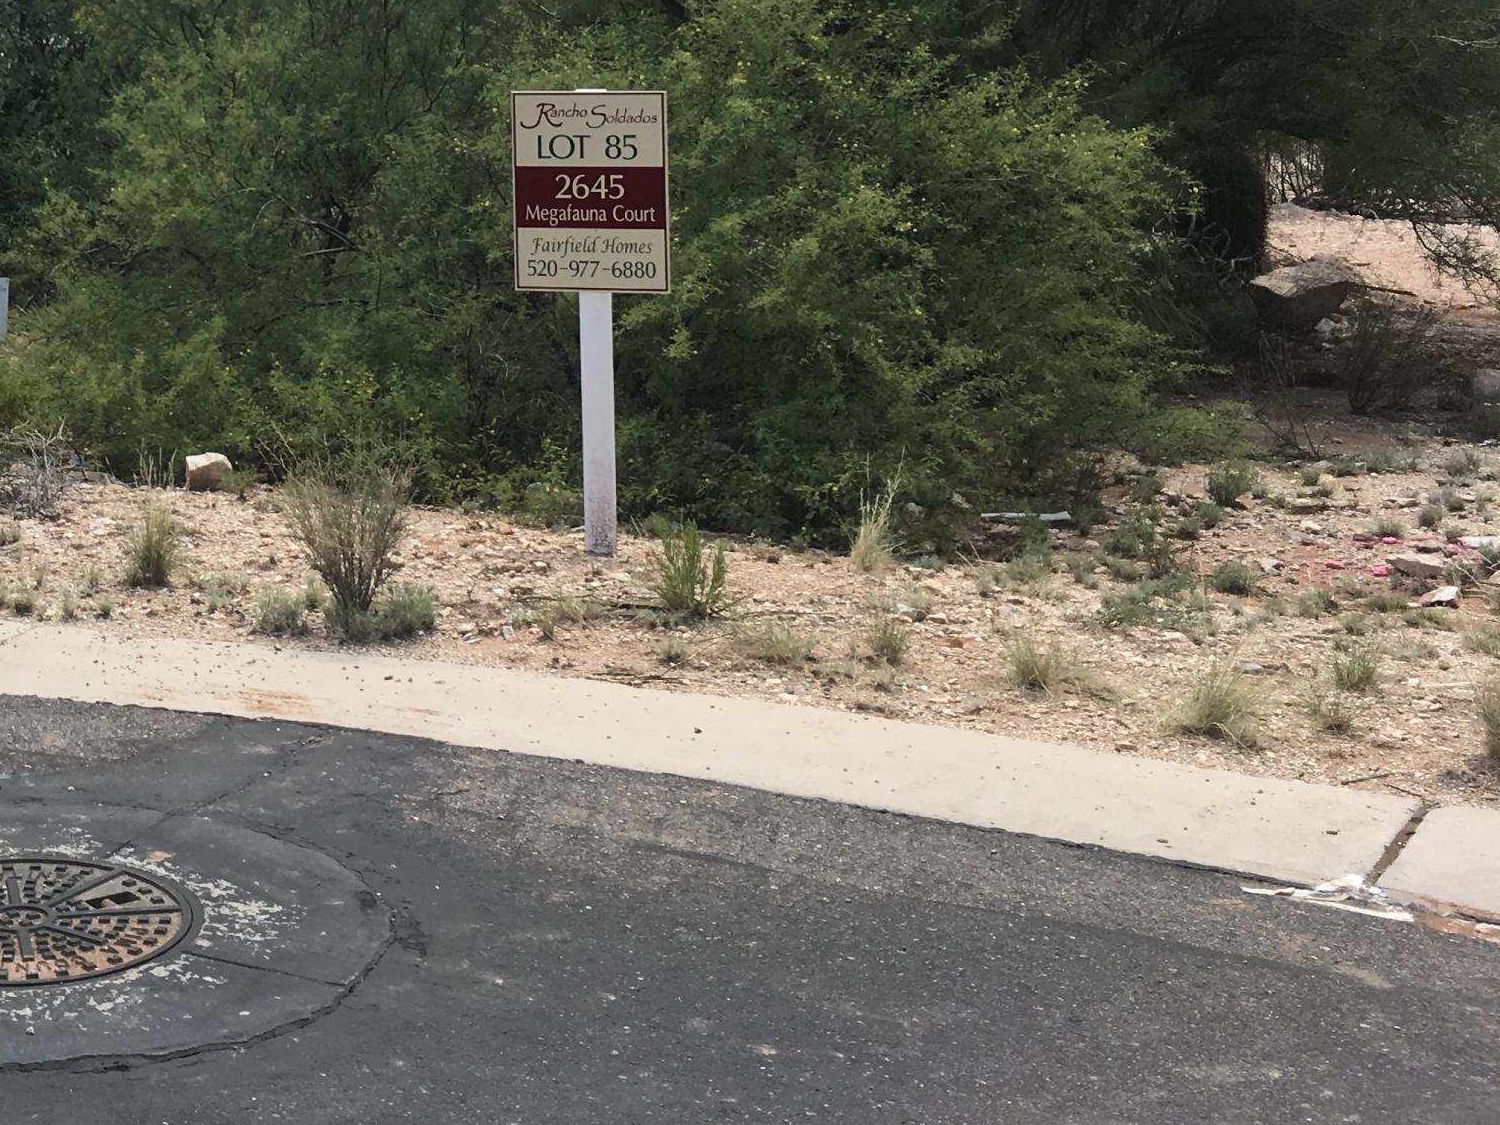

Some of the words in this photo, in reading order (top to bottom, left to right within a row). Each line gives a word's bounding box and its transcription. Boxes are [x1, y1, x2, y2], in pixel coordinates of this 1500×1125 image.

[519, 102, 587, 129] Rancho
[586, 104, 658, 129] Soldados
[537, 134, 591, 159] LOT
[605, 134, 638, 160] 85
[555, 174, 625, 200] 2645
[525, 204, 607, 226] Megafauna
[612, 205, 656, 222] Court
[530, 236, 600, 259] Fairfield
[600, 238, 653, 254] Homes
[527, 259, 656, 279] 520-977-6880
